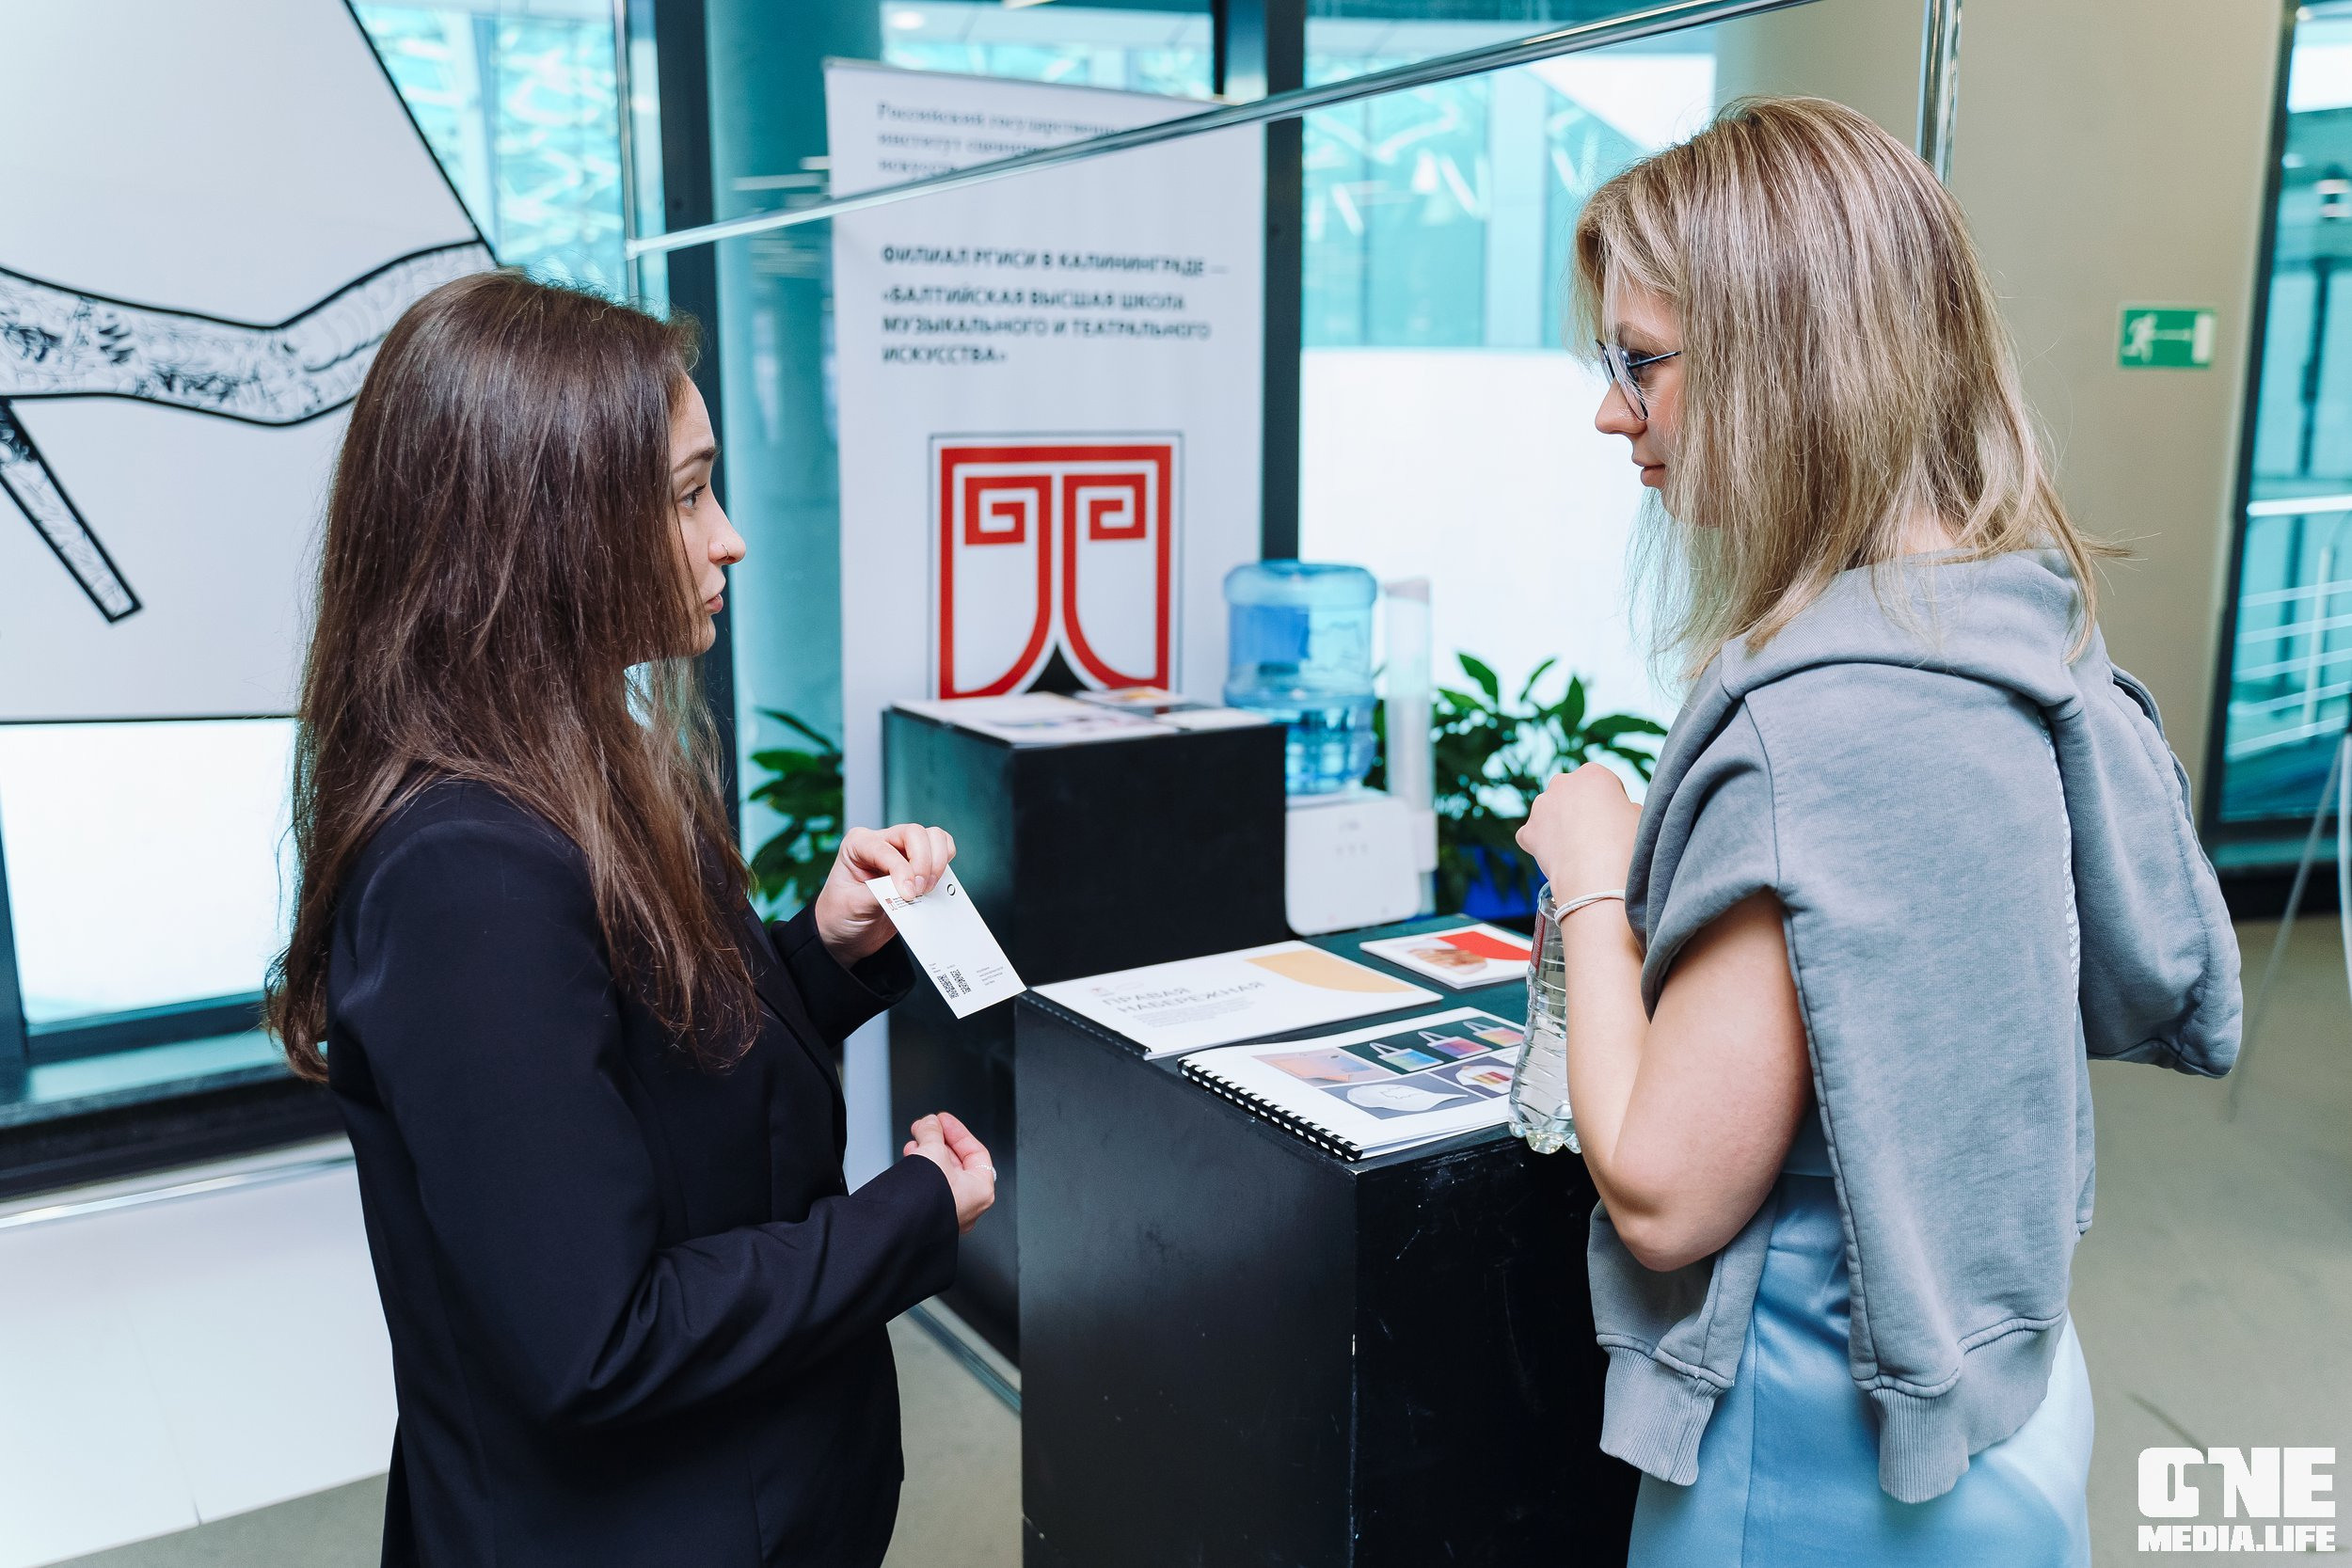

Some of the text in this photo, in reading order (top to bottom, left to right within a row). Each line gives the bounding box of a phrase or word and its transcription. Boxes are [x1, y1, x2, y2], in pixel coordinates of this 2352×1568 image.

[882, 246, 968, 265] ФИЛИАЛ
[1041, 253, 1052, 267] В
[1058, 253, 1205, 276] КАЛИНИНГРАДЕ
[1030, 291, 1115, 309] ВЫСШАЯ
[1121, 293, 1185, 310] ШКОЛА
[882, 317, 1212, 340] МУЗЫКАЛЬНОГО И ТЕАТРАЛЬНОГО
[1102, 987, 1191, 1006] ПРАВАЯ
[1116, 981, 1265, 1014] НАБЕРЕЖНАЯ
